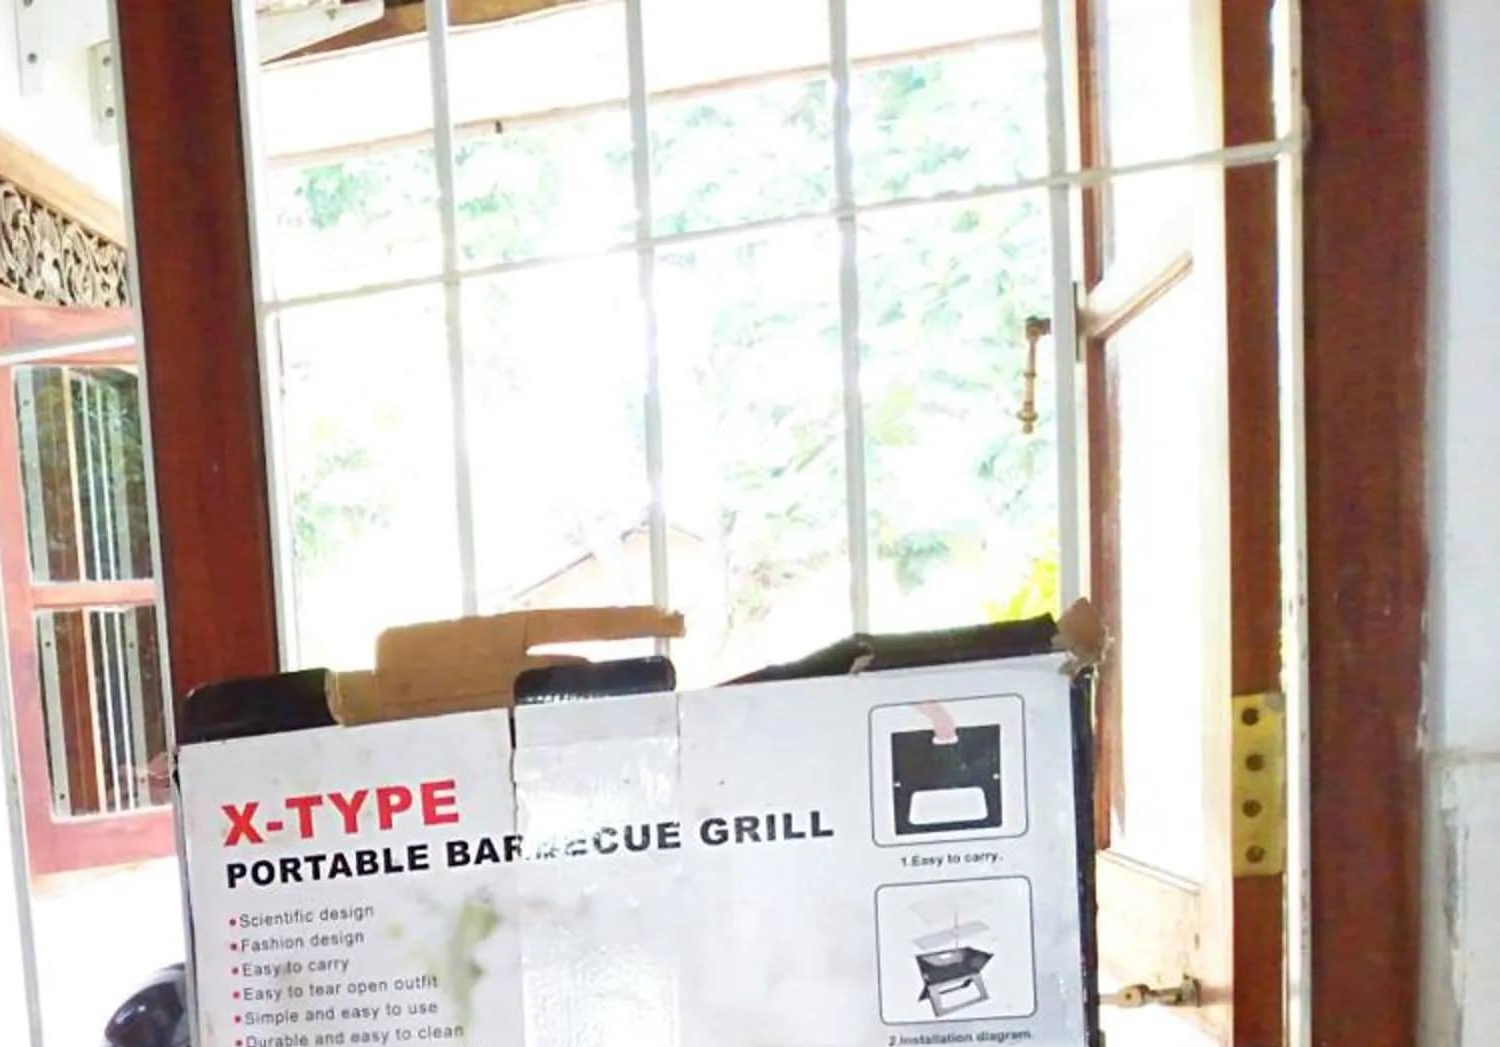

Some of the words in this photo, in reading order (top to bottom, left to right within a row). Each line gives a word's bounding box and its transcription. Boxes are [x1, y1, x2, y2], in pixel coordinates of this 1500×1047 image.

[222, 778, 461, 848] X-TYPE
[226, 845, 431, 889] PORTABLE
[446, 820, 682, 867] BARECUE
[700, 810, 835, 847] GRILL
[900, 854, 943, 868] 1.Easy
[947, 853, 961, 864] to
[239, 908, 315, 929] Scientific
[319, 904, 376, 923] design
[240, 935, 305, 953] Fashion
[310, 930, 365, 948] design
[242, 961, 281, 978] Easy
[287, 959, 302, 974] to
[308, 958, 350, 975] carry
[243, 986, 282, 1002] Easy
[288, 984, 303, 999] to
[309, 981, 341, 997] tear
[347, 979, 388, 997] open
[394, 974, 438, 990] outfit
[244, 1011, 299, 1027] Simple
[305, 1008, 335, 1022] and
[341, 1007, 379, 1022] easy
[385, 1002, 402, 1017] to
[408, 1003, 438, 1015] use
[314, 1031, 345, 1047] and
[351, 1031, 390, 1046] easy
[395, 1026, 411, 1042] to
[418, 1024, 464, 1040] clean
